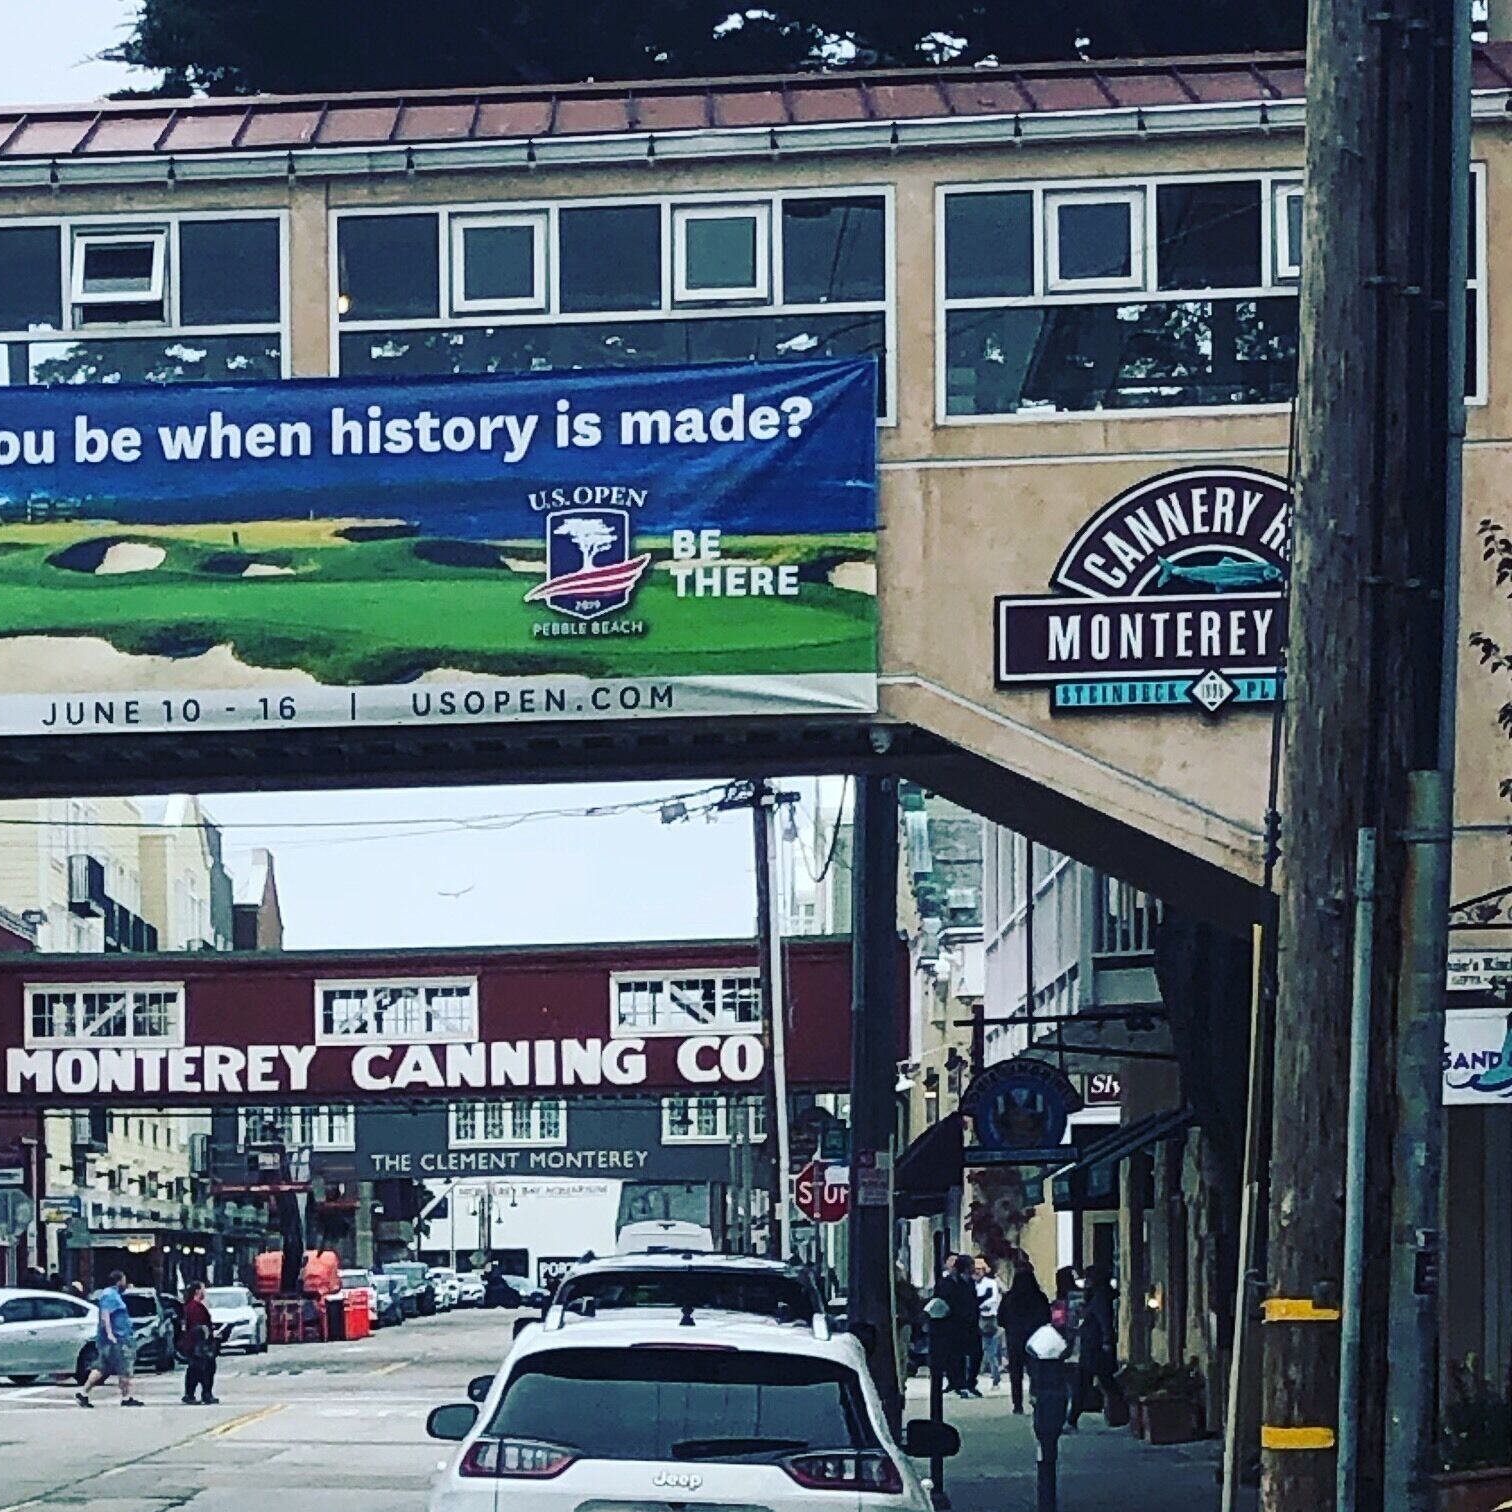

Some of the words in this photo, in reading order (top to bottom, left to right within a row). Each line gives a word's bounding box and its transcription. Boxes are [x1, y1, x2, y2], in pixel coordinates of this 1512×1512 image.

[75, 416, 142, 464] be
[157, 411, 312, 461] when
[331, 406, 538, 463] history
[555, 399, 601, 448] is
[620, 393, 814, 446] made?
[528, 489, 570, 511] U.S.
[573, 486, 648, 508] OPEN
[672, 529, 721, 560] BE
[1083, 486, 1264, 589] CANNERY
[669, 565, 799, 597] THERE
[533, 621, 587, 636] PEBBLE
[591, 620, 643, 634] BEACH
[1048, 609, 1273, 661] MONTEREY
[42, 700, 141, 727] JUNE
[161, 698, 202, 723] 10
[259, 695, 297, 721] 16
[412, 684, 676, 719] USOPEN.COM
[1062, 683, 1179, 705] STEINBECK
[1247, 682, 1270, 699] PL
[5, 1044, 317, 1094] MONTEREY
[351, 1037, 646, 1089] CANNING
[677, 1034, 765, 1083] CO
[1442, 1051, 1512, 1069] SAND
[371, 1154, 411, 1172] THE
[420, 1152, 520, 1172] CLEMENT
[530, 1150, 649, 1170] MONTEREY
[653, 1471, 703, 1491] Jeep
